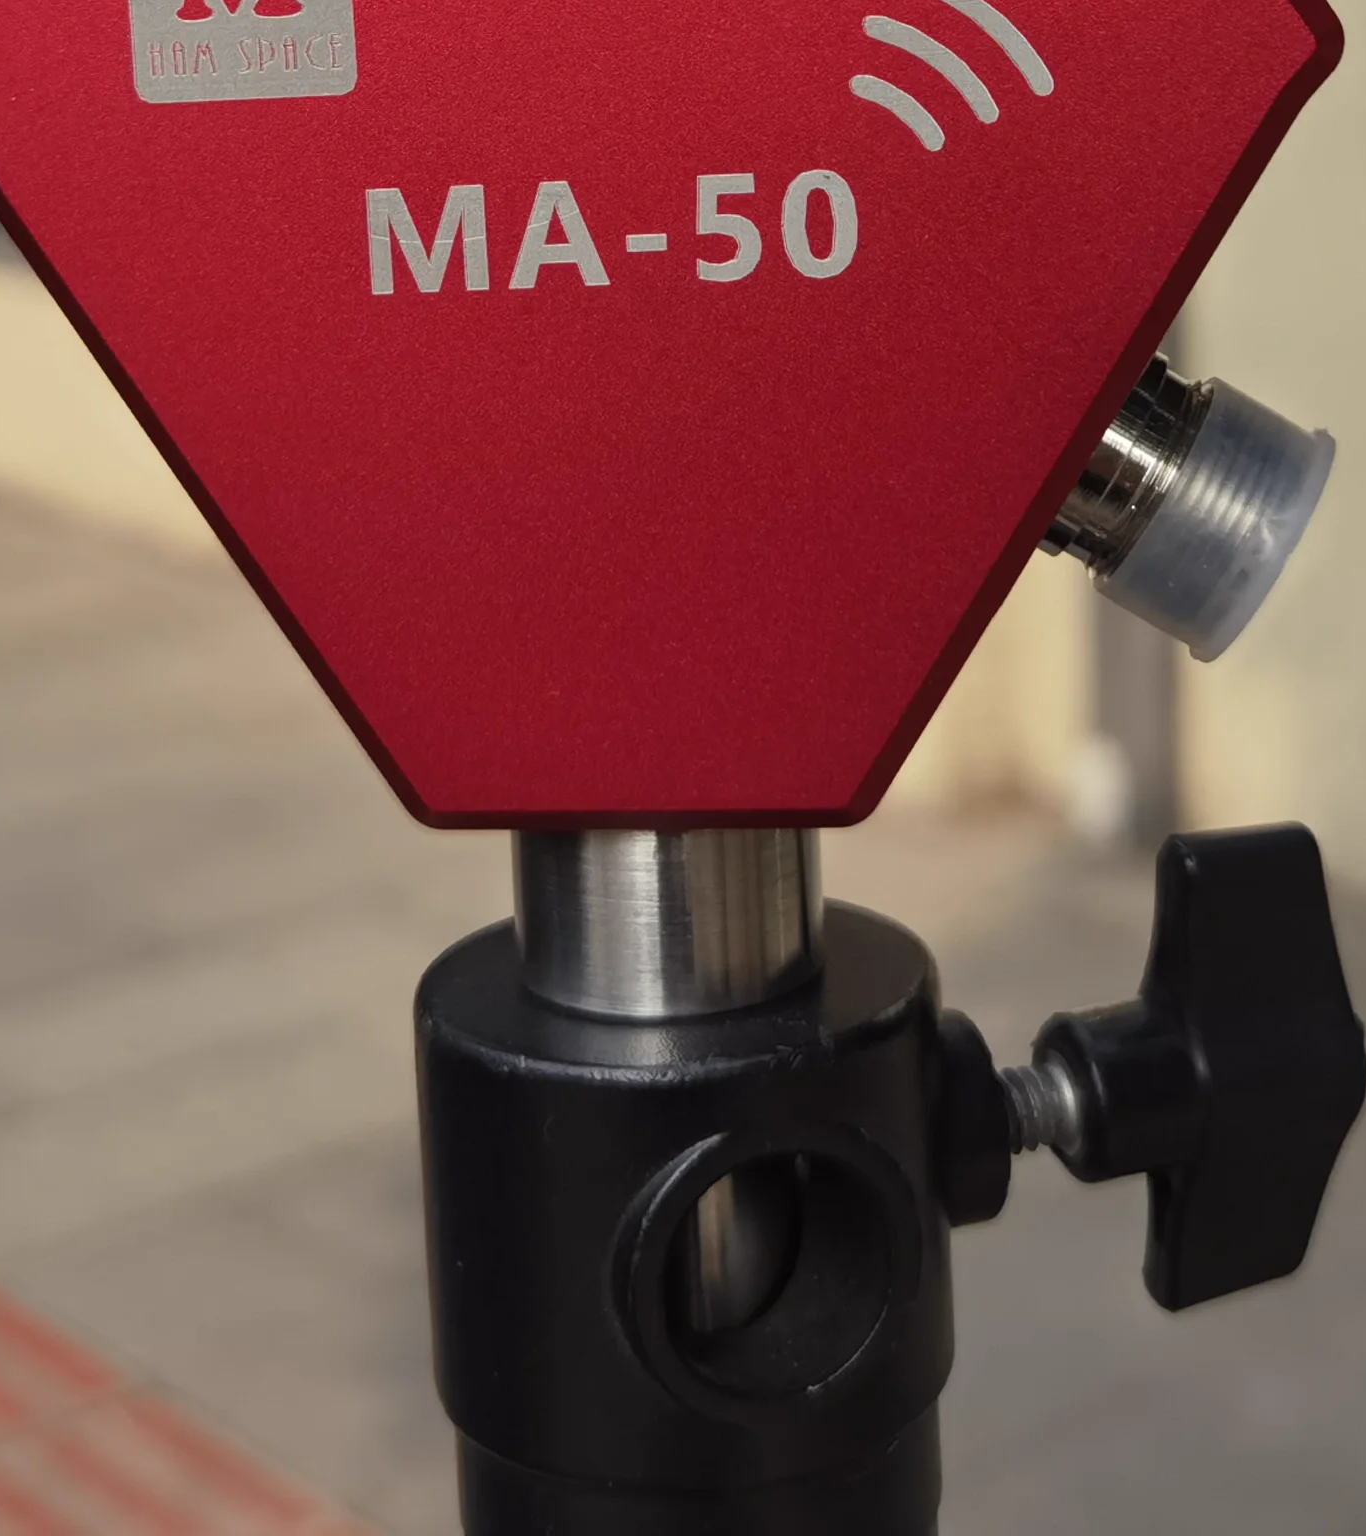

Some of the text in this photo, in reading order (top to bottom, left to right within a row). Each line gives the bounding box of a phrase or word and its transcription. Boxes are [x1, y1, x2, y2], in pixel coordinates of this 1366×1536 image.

[147, 32, 349, 79] HAM SPACE
[364, 169, 859, 295] MA-50
